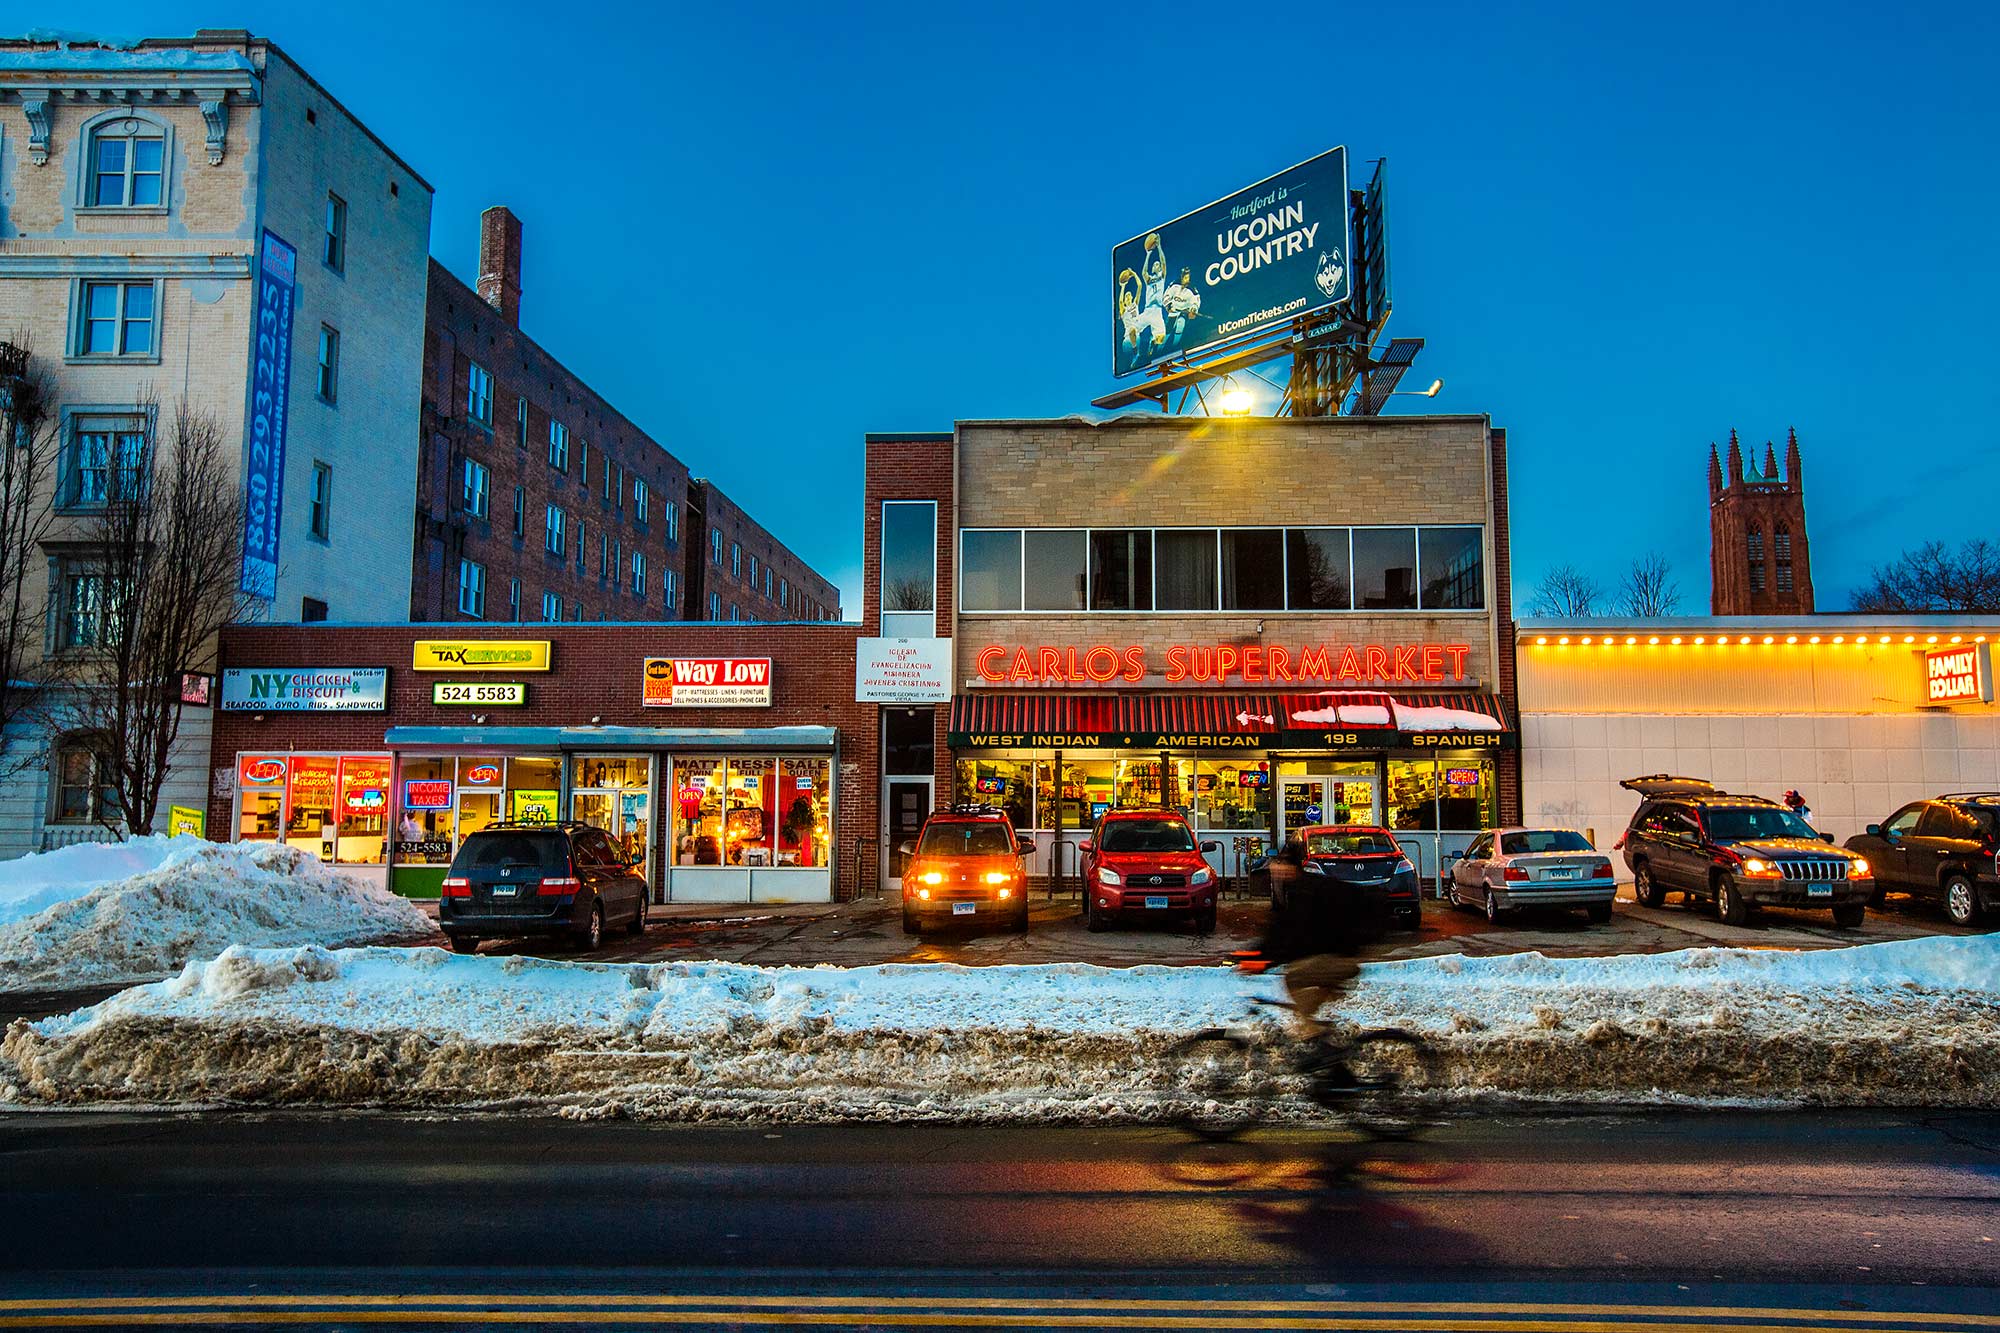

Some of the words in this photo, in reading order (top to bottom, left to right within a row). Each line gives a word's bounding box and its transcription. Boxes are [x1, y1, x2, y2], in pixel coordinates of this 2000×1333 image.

[1230, 192, 1275, 220] Hartford
[1278, 187, 1288, 200] is
[1217, 200, 1304, 254] UCONN
[1205, 222, 1320, 286] COUNTRY
[1218, 297, 1307, 334] UConnTickets.com
[1311, 323, 1338, 337] LAMAR
[432, 649, 467, 664] TAX
[467, 650, 533, 662] SERVICES
[977, 646, 1146, 682] CARLOS
[1166, 645, 1470, 681] SUPERMARKET
[1928, 652, 1975, 678] FAMILY
[674, 661, 718, 684] Way
[724, 661, 767, 682] Low
[250, 674, 292, 698] NY
[292, 674, 351, 686] CHICKEN
[292, 688, 345, 698] BISCUIT
[352, 681, 360, 693] &
[646, 687, 672, 696] STORE
[1929, 675, 1975, 698] DOLLAR
[442, 687, 471, 700] 524
[477, 687, 516, 700] 5583
[225, 701, 267, 709] SEAFOOD
[274, 701, 300, 709] GYRO
[308, 701, 328, 709] RIBS
[335, 701, 383, 709] SANDWICH
[970, 735, 1024, 746] WEST
[1032, 735, 1099, 746] INDIAN
[1155, 735, 1260, 746] AMERICAN
[1324, 733, 1358, 744] 198
[1412, 735, 1500, 746] SPANISH
[247, 763, 282, 777] OPEN
[674, 760, 721, 769] MATT
[730, 760, 774, 769] RESS
[784, 760, 828, 769] SALE
[301, 770, 328, 778] BURGER
[469, 769, 498, 780] OPEN
[1240, 773, 1267, 785] OPEN
[1451, 772, 1475, 782] OPEN
[409, 783, 449, 793] INCOME
[978, 777, 1005, 791] OPEN
[412, 795, 445, 805] TAXES
[679, 791, 700, 800] OPEN
[525, 804, 544, 812] GET
[522, 811, 547, 821] $50
[179, 821, 193, 829] GET
[401, 842, 447, 853] 524-5583
